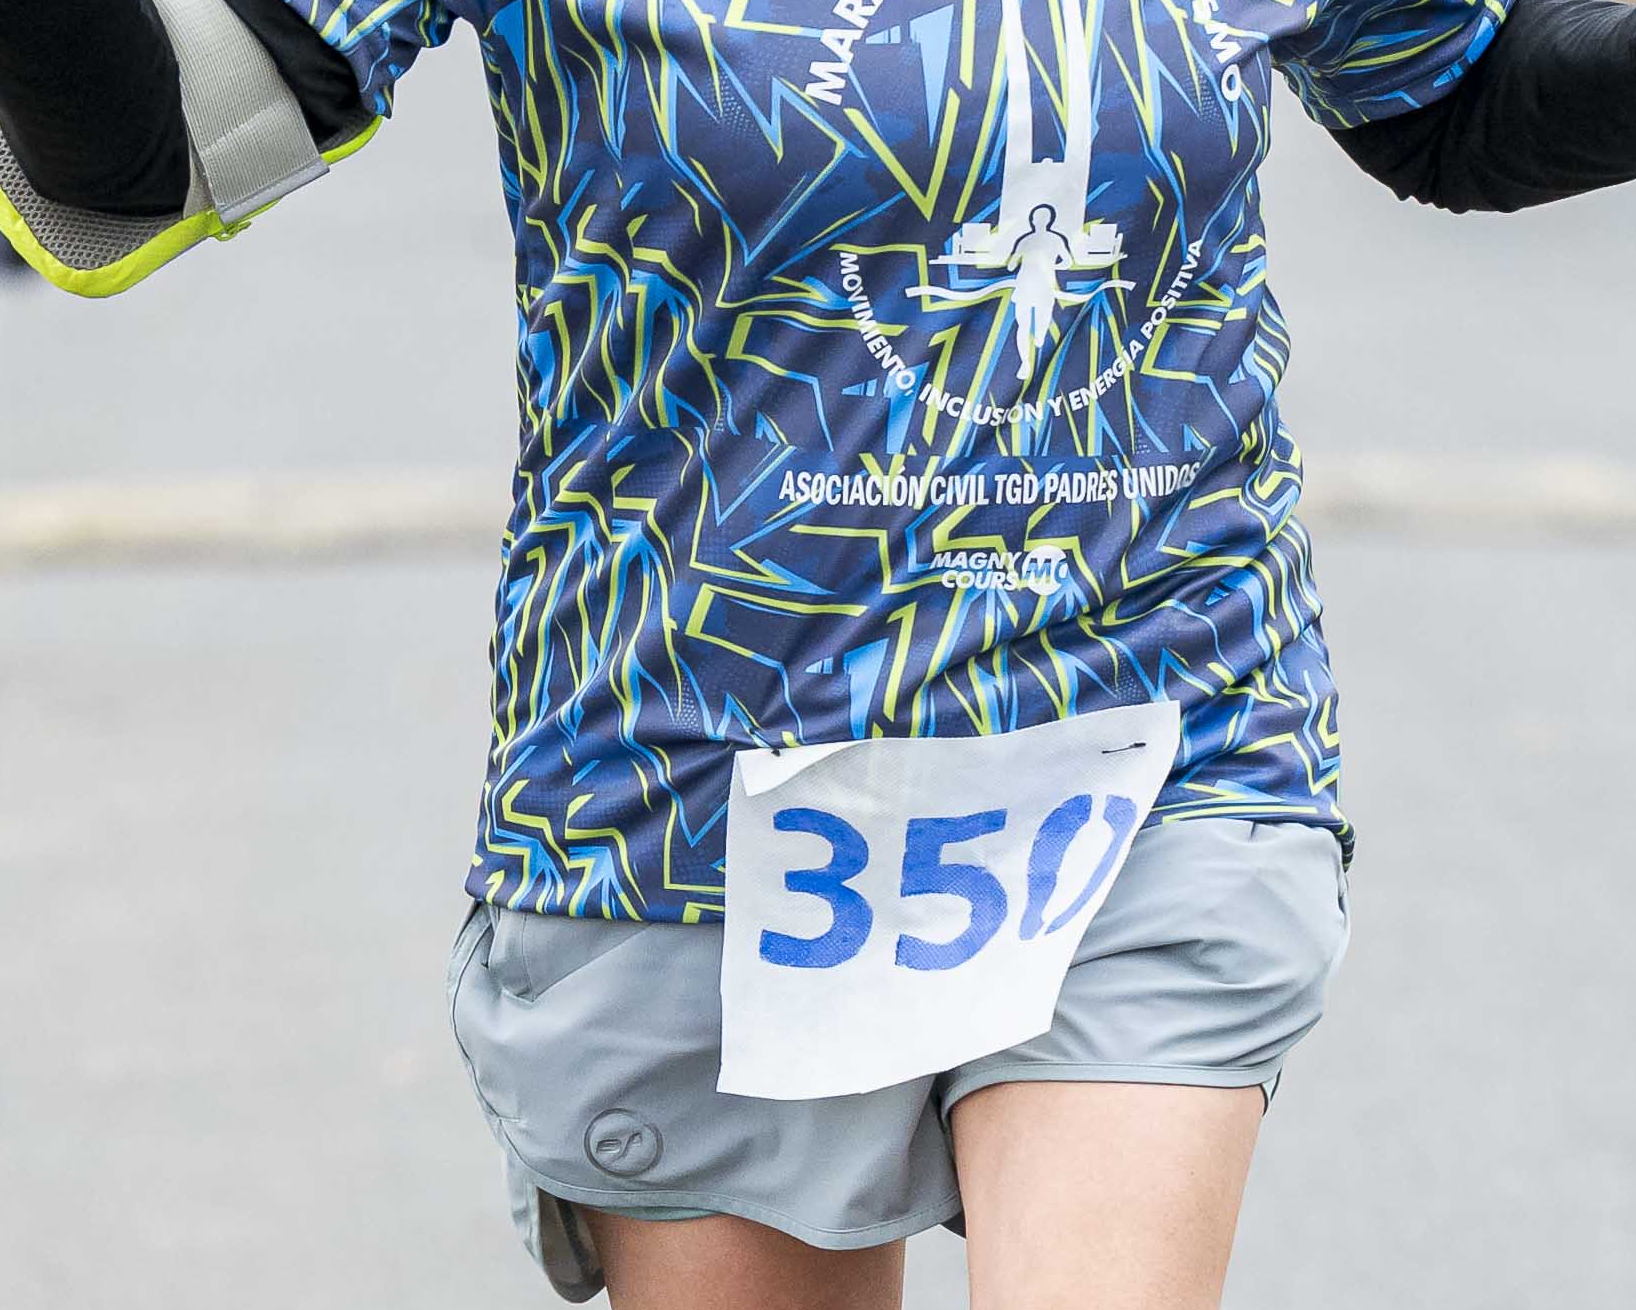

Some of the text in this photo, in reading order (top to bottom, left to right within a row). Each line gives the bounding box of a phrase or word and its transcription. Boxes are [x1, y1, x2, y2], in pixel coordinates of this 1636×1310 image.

[839, 252, 916, 397] MOVIMIENTO,
[1047, 395, 1063, 417] Y
[1140, 239, 1205, 340] POSITIVA
[778, 462, 1201, 507] ASOCIACIÓN CIVIL TGD PADRES UNIDOS
[930, 551, 1023, 571] MAGNY
[941, 569, 1019, 592] COURS
[759, 794, 1139, 972] 350
